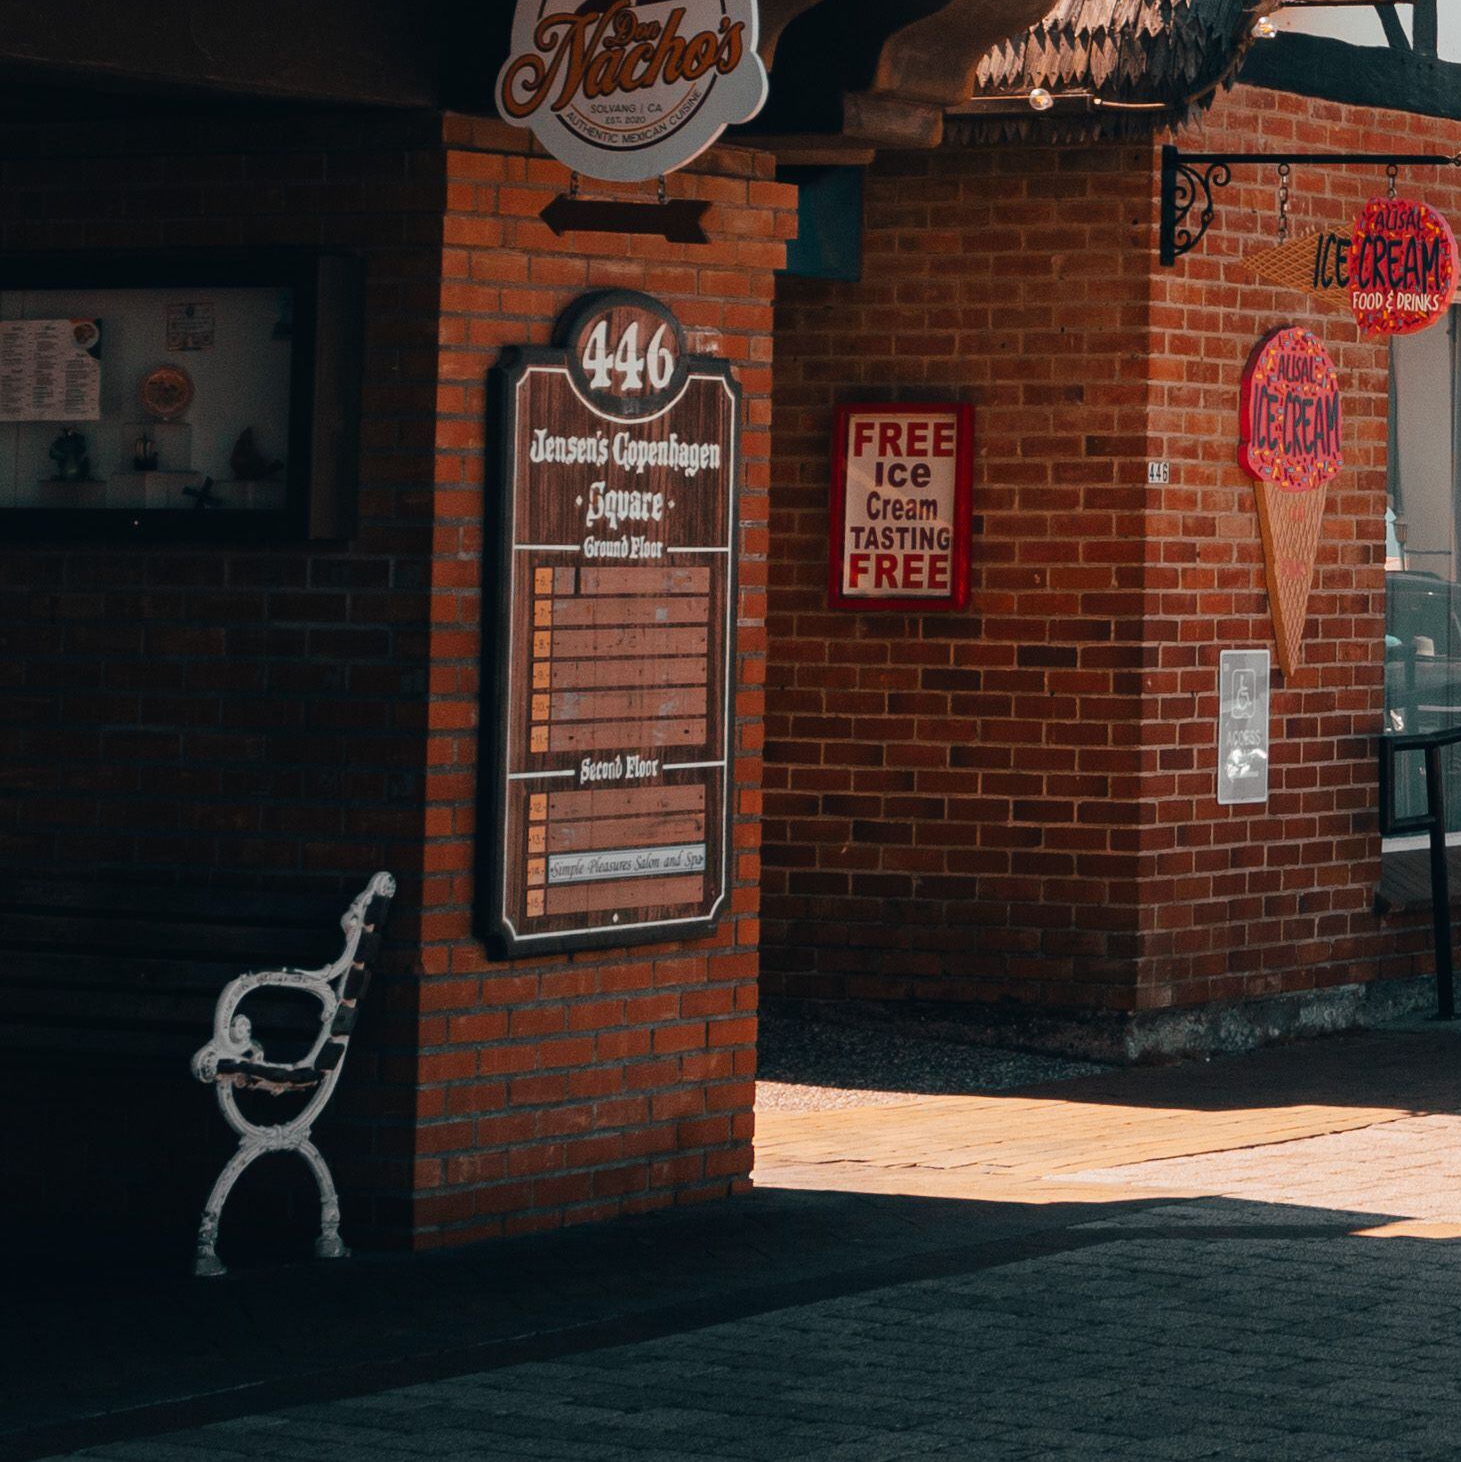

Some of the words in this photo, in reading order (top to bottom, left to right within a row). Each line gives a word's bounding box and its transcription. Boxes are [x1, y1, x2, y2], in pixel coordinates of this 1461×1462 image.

[566, 111, 618, 144] AUTHENTIC
[621, 123, 668, 144] MEXICAN
[668, 89, 703, 126] CUISINE
[590, 103, 636, 114] SOLVANG
[647, 103, 663, 114] CA
[625, 116, 646, 125] 2020
[1373, 209, 1424, 231] ALISAL
[1313, 233, 1353, 289] ICE
[1358, 235, 1441, 295] CREAM
[1352, 291, 1383, 310] FOOD
[1385, 290, 1395, 313] &
[1396, 292, 1440, 312] DRINKS
[581, 320, 676, 391] 446
[1277, 354, 1316, 384] ALISAL
[1251, 383, 1279, 451] ICE
[1283, 389, 1340, 459] CREAM
[529, 427, 609, 467] Jensen's
[611, 431, 721, 478] Copenhagen
[852, 422, 955, 458] FREE
[874, 461, 932, 489] Ice
[1149, 463, 1168, 482] 446
[586, 481, 663, 530] Square
[866, 490, 938, 521] Cream
[583, 535, 628, 558] Ground
[630, 538, 663, 560] Floor
[850, 526, 951, 551] TASTING
[848, 552, 950, 589] FREE
[579, 757, 623, 784] Second
[624, 755, 660, 779] Floor
[551, 858, 584, 880] Simple
[586, 855, 633, 875] Pleasures
[633, 852, 661, 873] Salon
[663, 849, 682, 868] and
